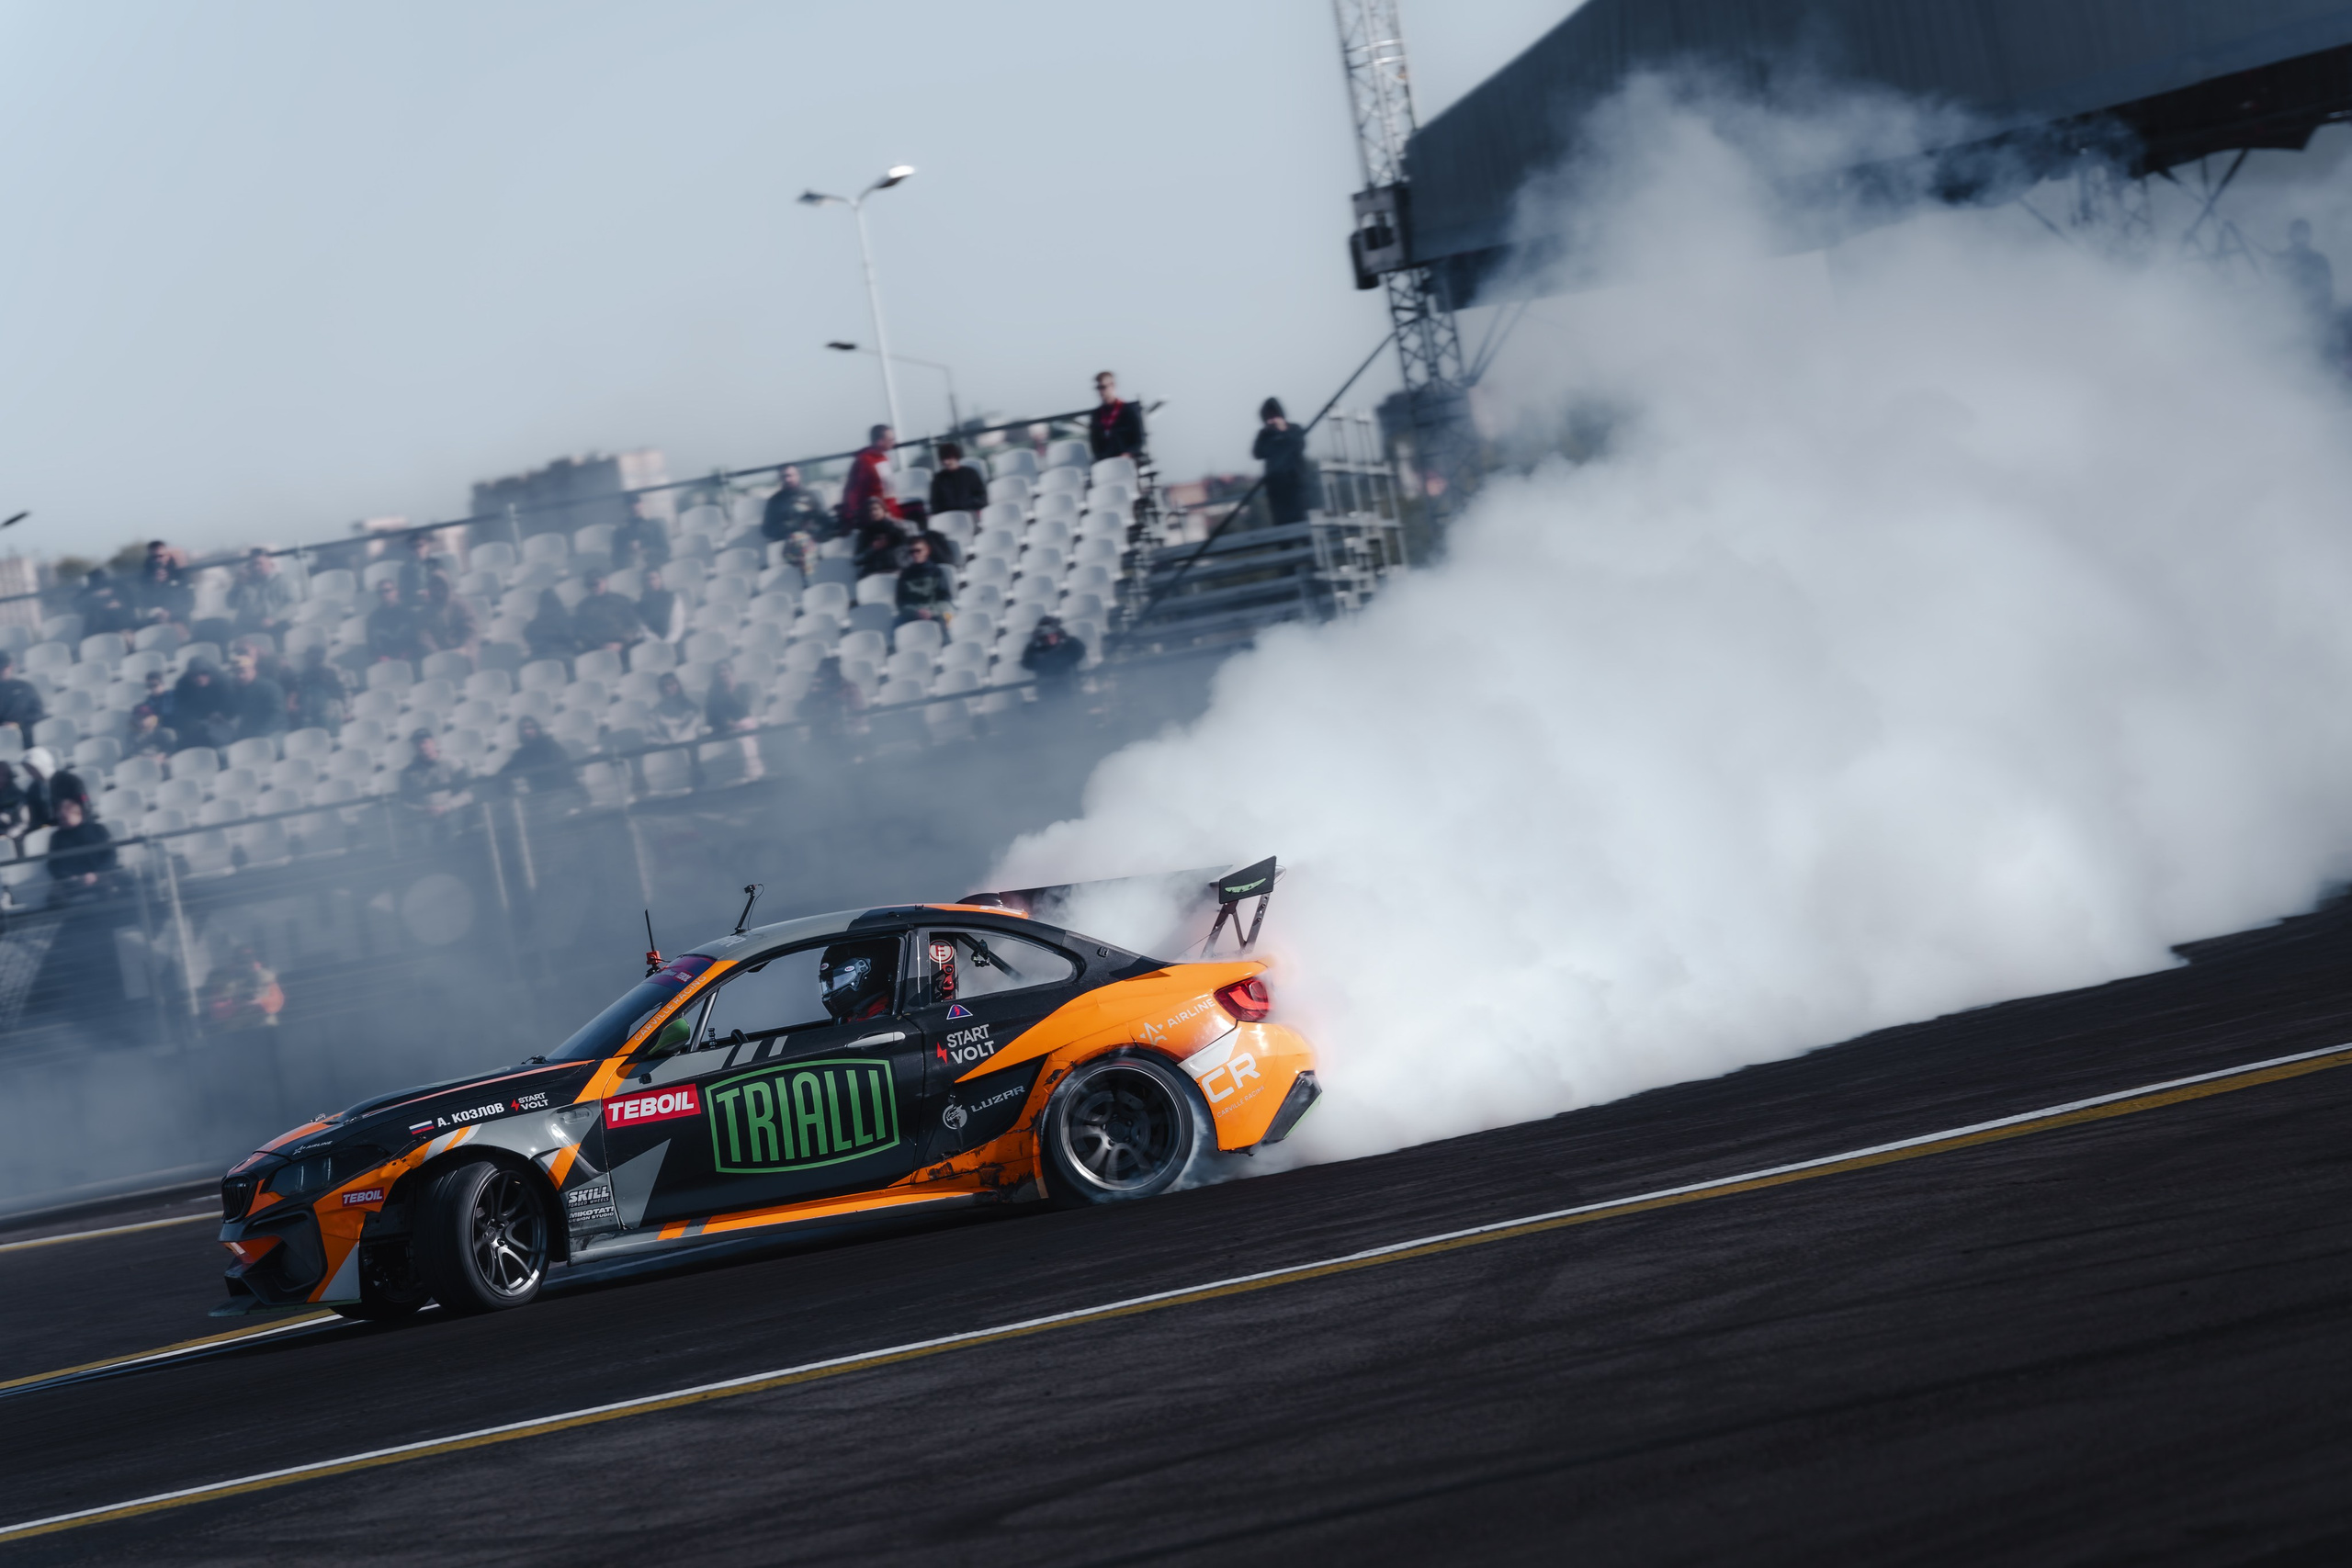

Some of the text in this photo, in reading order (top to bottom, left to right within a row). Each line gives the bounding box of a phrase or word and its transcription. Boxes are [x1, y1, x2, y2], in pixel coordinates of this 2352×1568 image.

[634, 975, 707, 1042] CARVILLE RACING
[1166, 998, 1216, 1029] AIRLINE
[946, 1023, 989, 1048] START
[950, 1040, 995, 1065] VOLT
[1201, 1052, 1261, 1103] CR
[517, 1091, 546, 1104] START
[520, 1099, 549, 1111] VOLT
[607, 1090, 695, 1122] TEBOIL
[970, 1085, 1025, 1113] LUZAR
[1216, 1098, 1245, 1119] CARVILLE
[451, 1102, 505, 1123] КОЗЛОВ
[716, 1069, 887, 1163] TRIALLI
[343, 1190, 383, 1204] TEBOIL
[568, 1186, 610, 1204] SKILL
[569, 1205, 615, 1219] MIKOTATI
[591, 1211, 615, 1220] STUDIO
